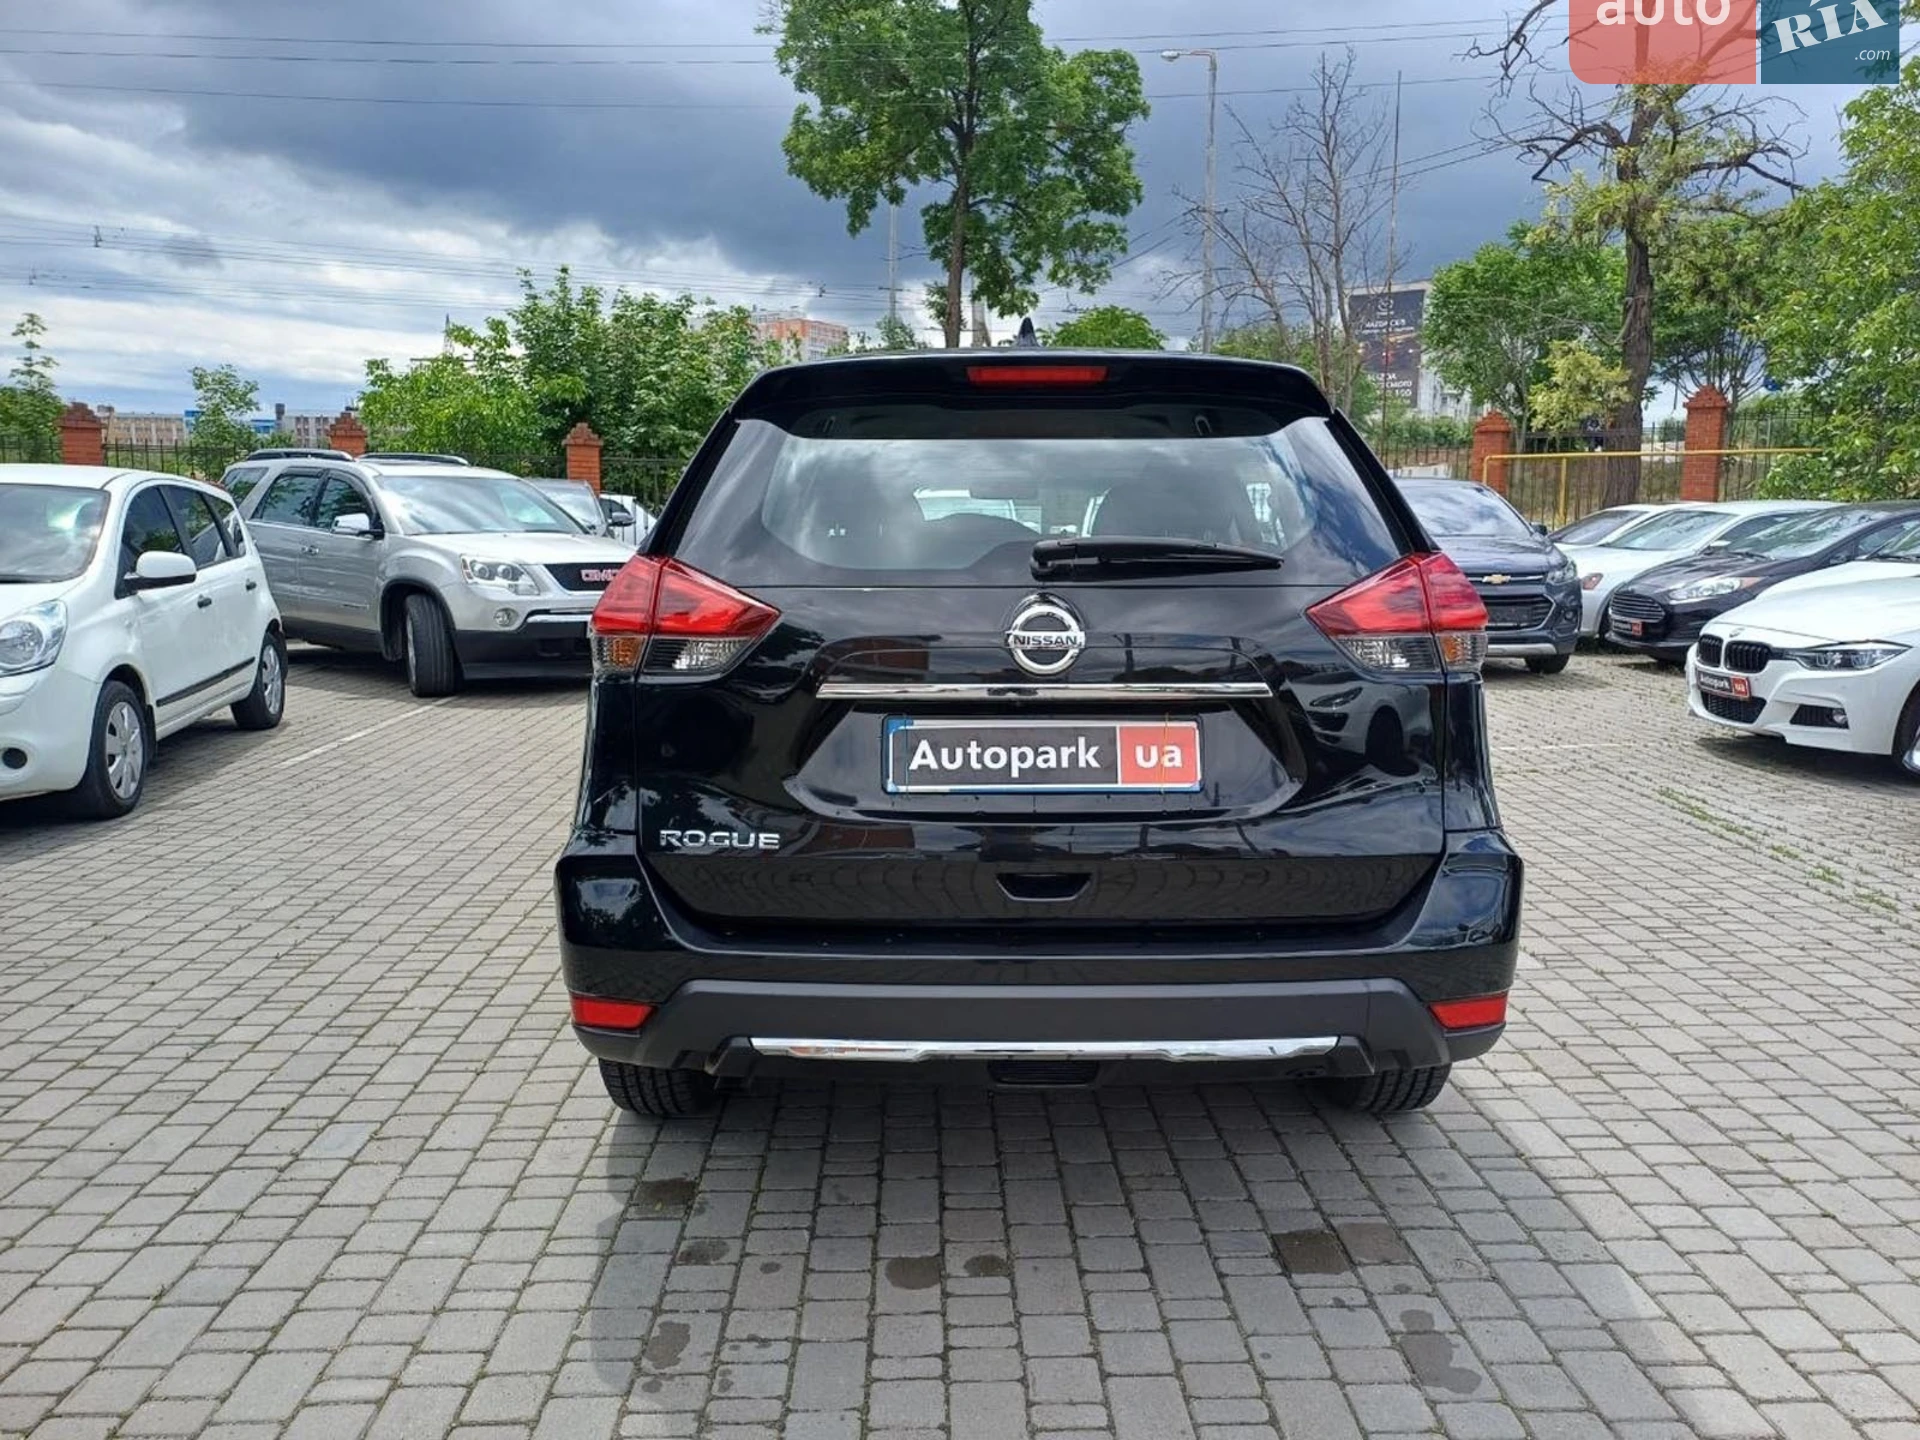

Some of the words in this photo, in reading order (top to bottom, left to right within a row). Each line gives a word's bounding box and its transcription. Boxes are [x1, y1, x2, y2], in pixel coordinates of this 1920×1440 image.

[1013, 635, 1078, 646] NISSAN
[908, 735, 1101, 778] Autopark
[1134, 744, 1183, 769] ua
[659, 829, 780, 850] ROGUE
